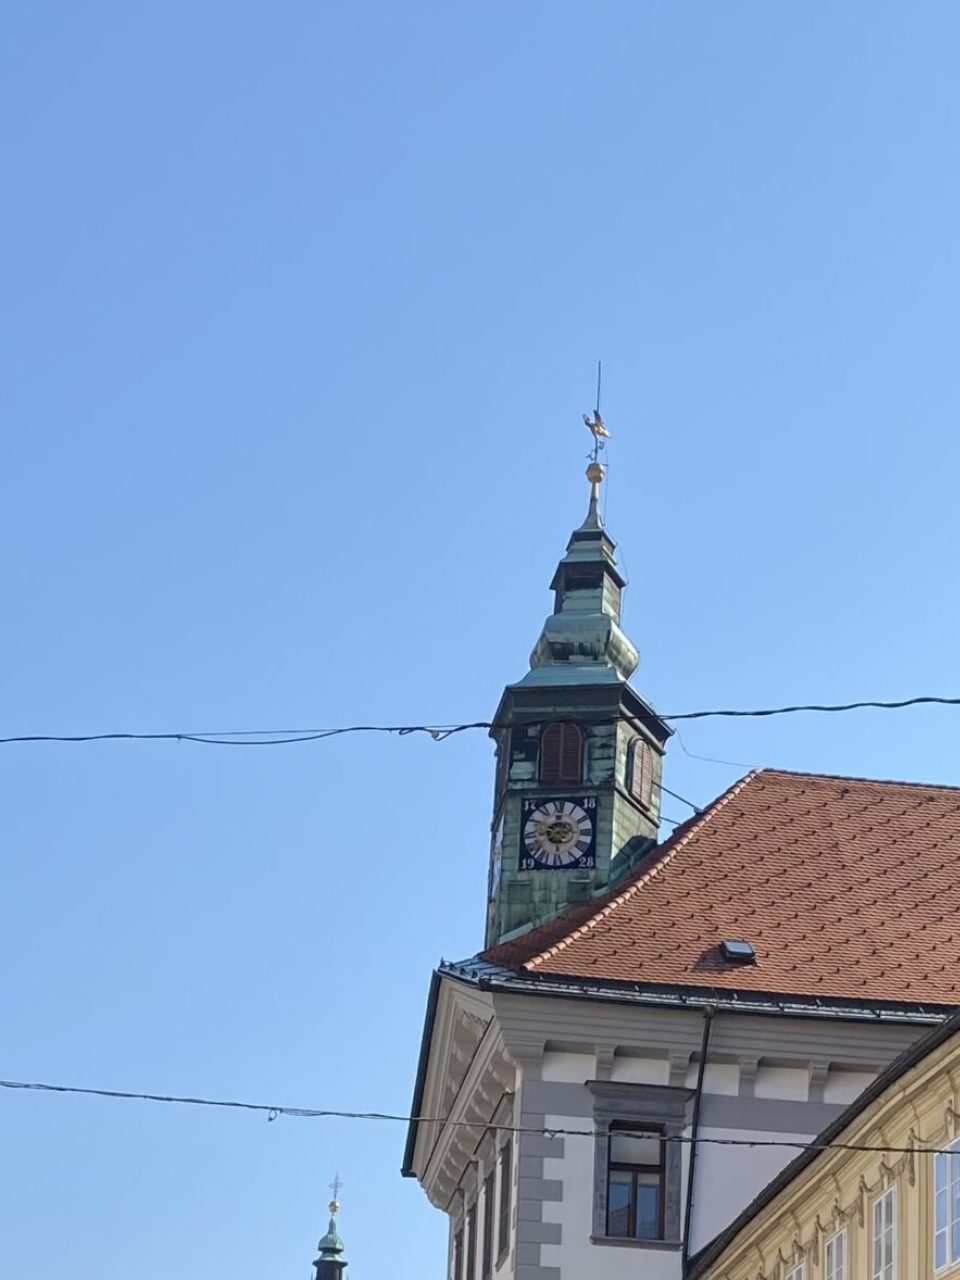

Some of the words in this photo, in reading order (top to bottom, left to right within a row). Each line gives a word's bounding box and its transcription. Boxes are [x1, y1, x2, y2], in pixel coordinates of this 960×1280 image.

[583, 798, 596, 809] 18
[522, 858, 535, 869] 19
[579, 856, 594, 867] 28
